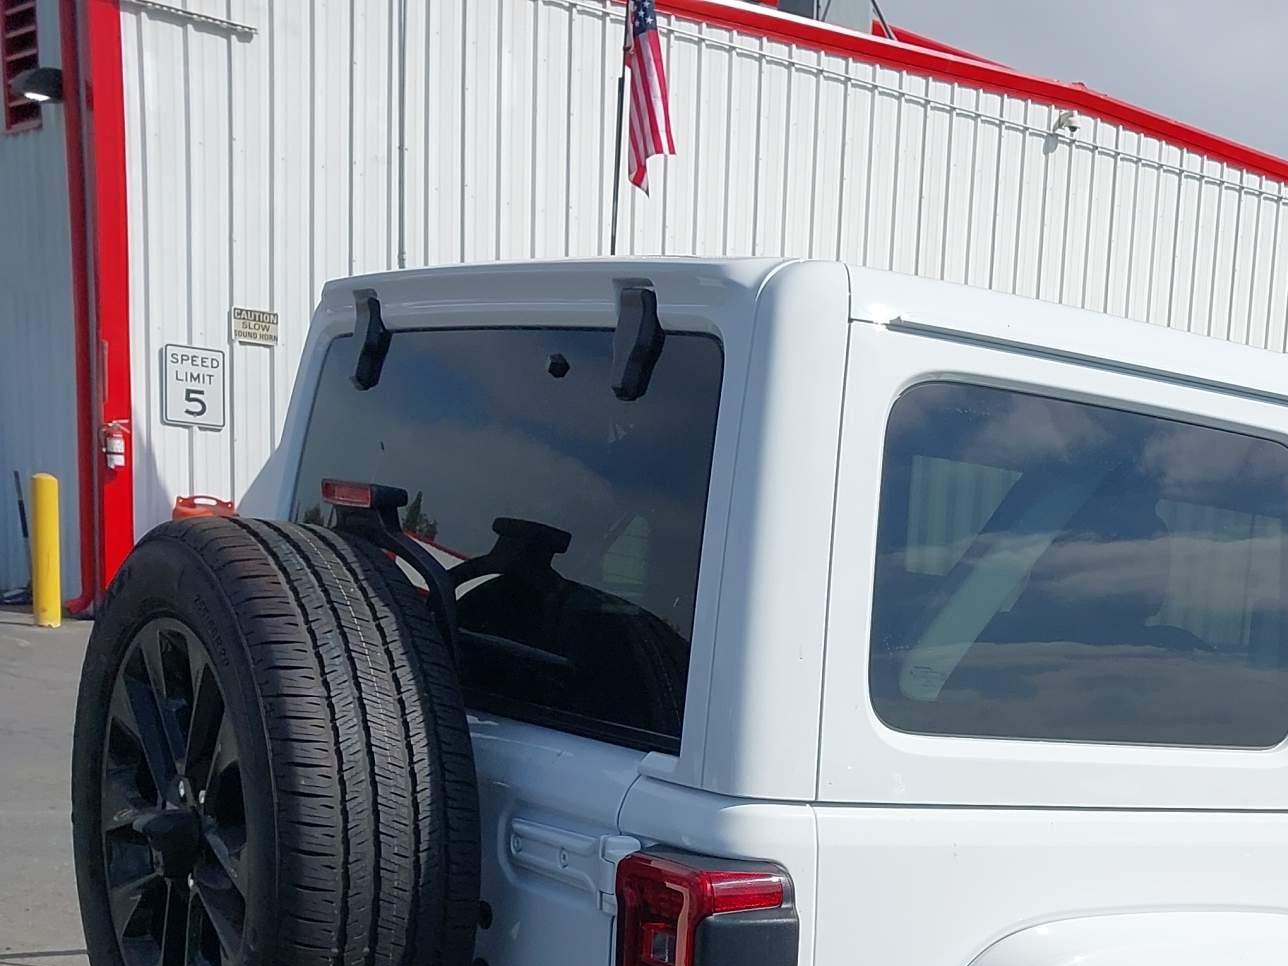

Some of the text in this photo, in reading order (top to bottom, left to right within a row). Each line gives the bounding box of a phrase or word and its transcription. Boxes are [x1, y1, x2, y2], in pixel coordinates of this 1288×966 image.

[234, 309, 278, 325] CAUTION
[242, 321, 270, 332] SLOW
[234, 330, 258, 339] SOUND
[170, 352, 220, 369] SPEED
[175, 370, 214, 385] LIMIT
[184, 388, 207, 416] 5
